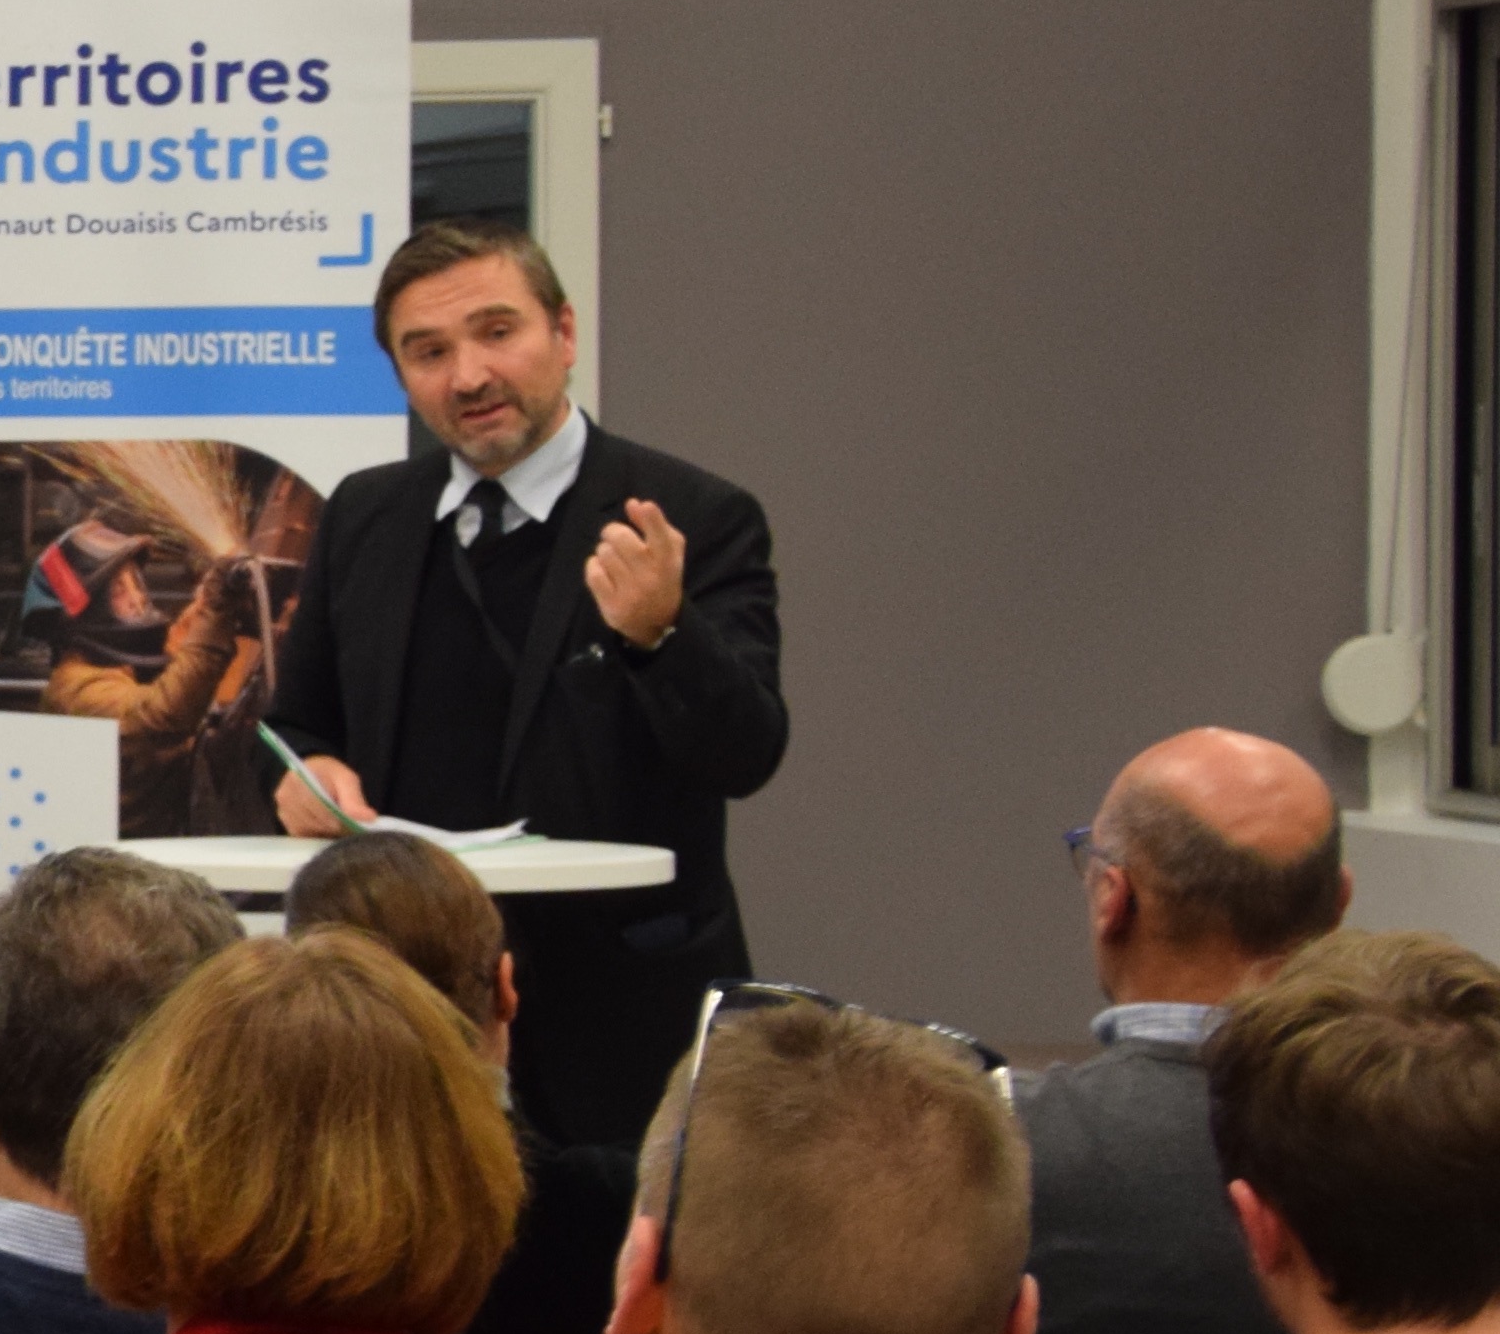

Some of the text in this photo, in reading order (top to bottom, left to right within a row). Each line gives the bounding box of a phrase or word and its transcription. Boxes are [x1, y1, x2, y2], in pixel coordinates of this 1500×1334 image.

[66, 211, 177, 236] Douaisis
[186, 208, 328, 234] Cambrésis
[135, 331, 336, 366] INDUSTRIELLE
[10, 375, 113, 400] territoires
